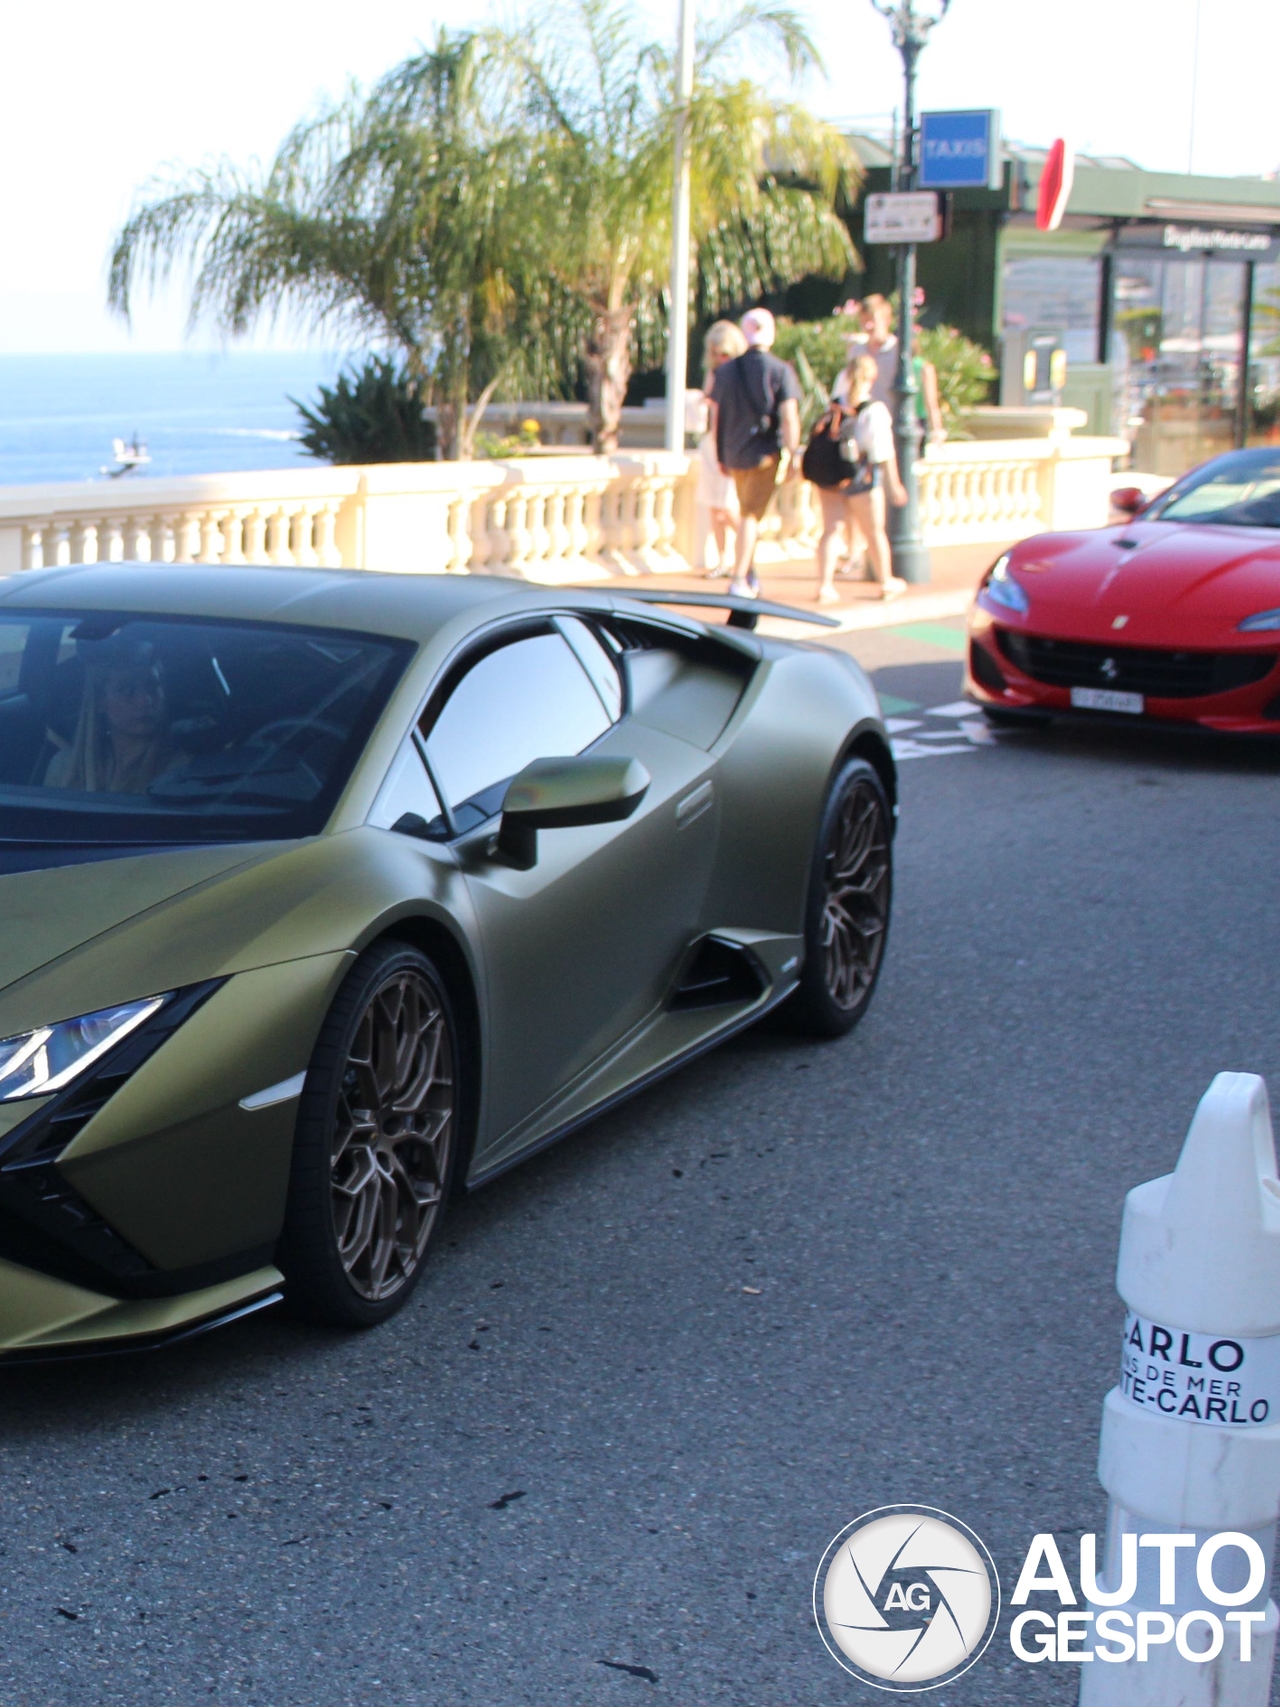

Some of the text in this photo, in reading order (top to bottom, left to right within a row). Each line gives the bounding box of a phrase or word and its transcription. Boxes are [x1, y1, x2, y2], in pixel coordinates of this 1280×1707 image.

[926, 139, 986, 157] TAXIS
[1123, 1311, 1244, 1372] ARLO
[1146, 1365, 1176, 1387] DE
[1187, 1376, 1242, 1397] MER
